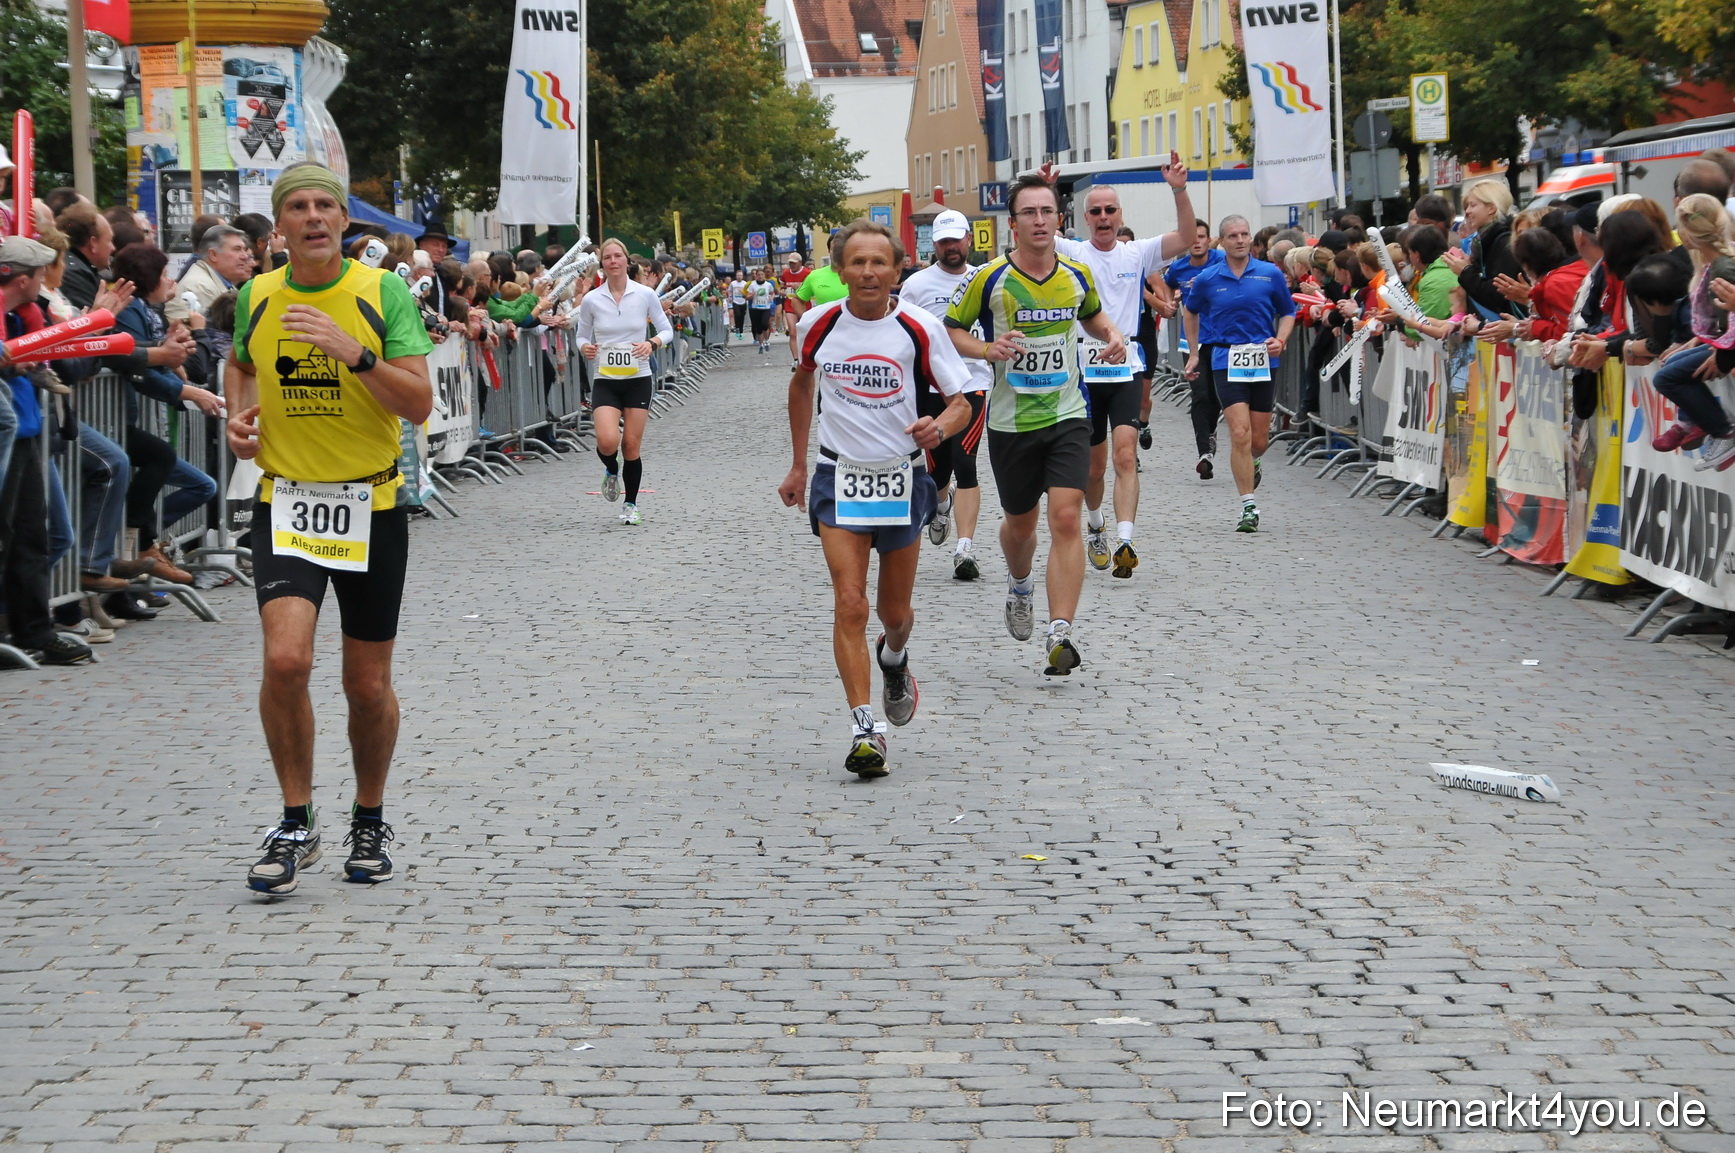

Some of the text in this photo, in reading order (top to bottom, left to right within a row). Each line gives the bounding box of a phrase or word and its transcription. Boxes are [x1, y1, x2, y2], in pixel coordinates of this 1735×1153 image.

[1144, 89, 1161, 109] HOTEL
[979, 230, 989, 244] D
[708, 238, 719, 253] D
[1015, 307, 1075, 322] BOCK
[18, 326, 64, 347] Audi BKK
[1029, 341, 1058, 349] Neumarkt
[607, 351, 631, 366] 600
[1013, 349, 1064, 372] 2879
[1233, 352, 1265, 367] 2513
[823, 362, 891, 377] GERHART
[1094, 368, 1122, 377] Matthias
[853, 375, 899, 389] JÄNIG
[1024, 376, 1052, 386] Tobias
[282, 388, 341, 400] HIRSCH
[834, 388, 846, 400] Das
[846, 396, 879, 410] sportliche
[838, 462, 899, 474] PARTL Neumarkt
[843, 472, 905, 498] 3353
[275, 486, 354, 500] PARTL Neumarkt
[291, 501, 351, 535] 300
[290, 536, 350, 557] Alexander
